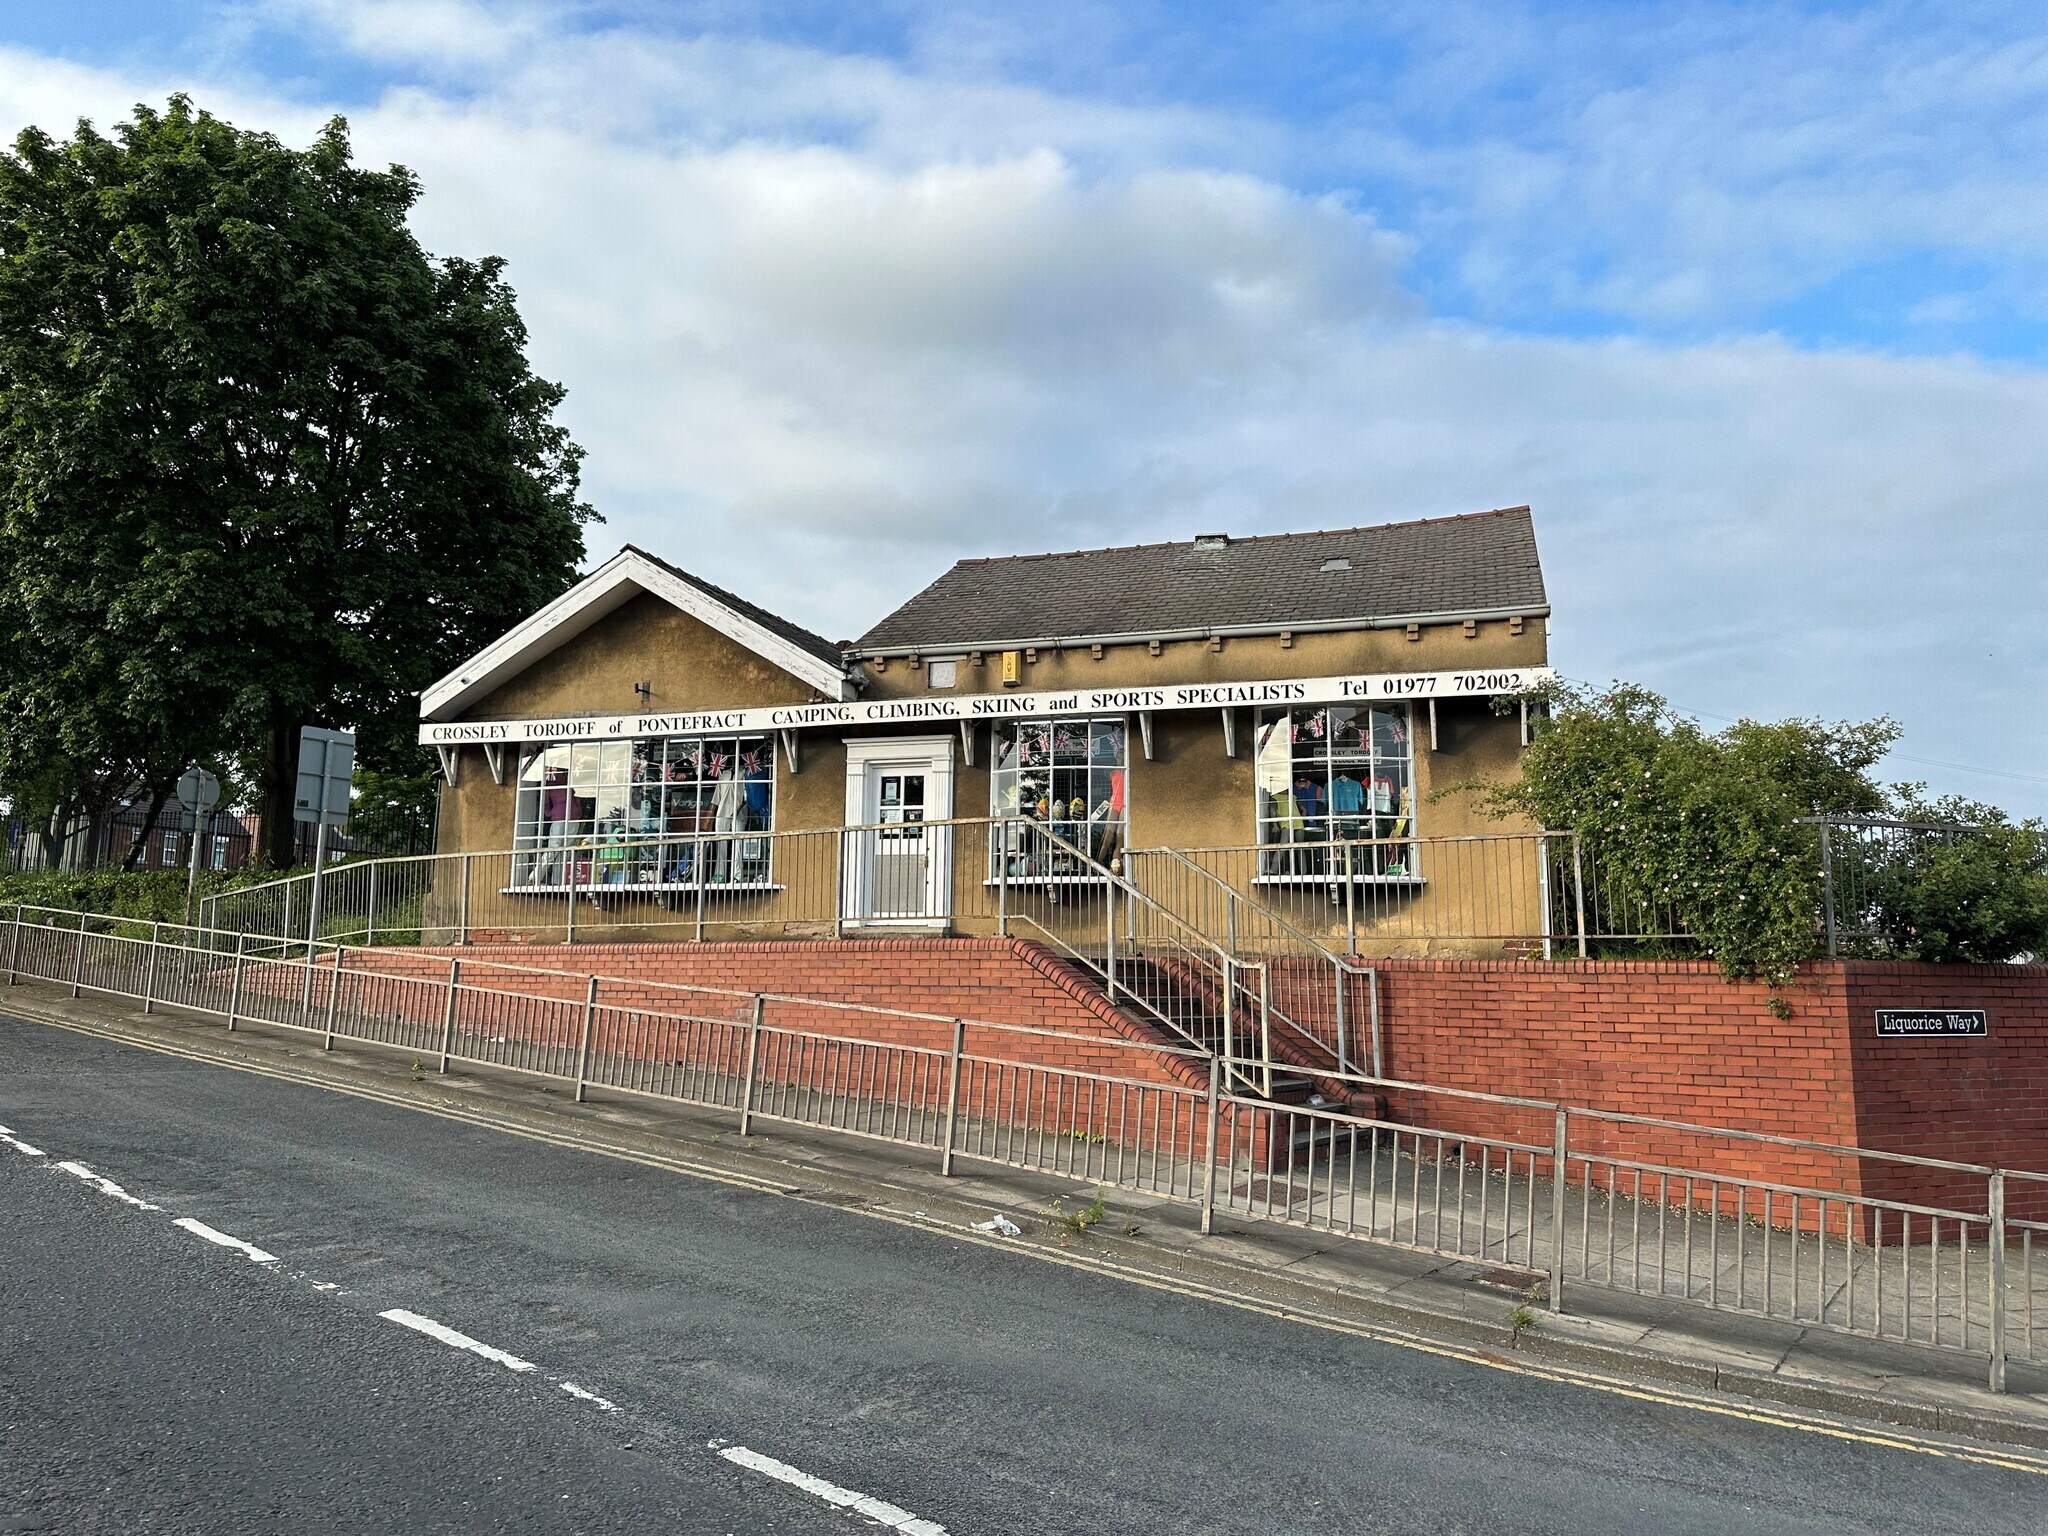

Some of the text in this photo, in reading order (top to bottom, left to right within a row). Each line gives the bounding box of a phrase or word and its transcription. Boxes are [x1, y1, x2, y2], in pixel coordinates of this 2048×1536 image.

[433, 673, 1522, 740] CROSSLEY TORDOFF of PONTEFRACT CAMPING, CLIMBING, SKIING and SPORTS SPECIALISTS Tel 01977 702002
[1883, 1015, 1972, 1032] Liquorice Way
